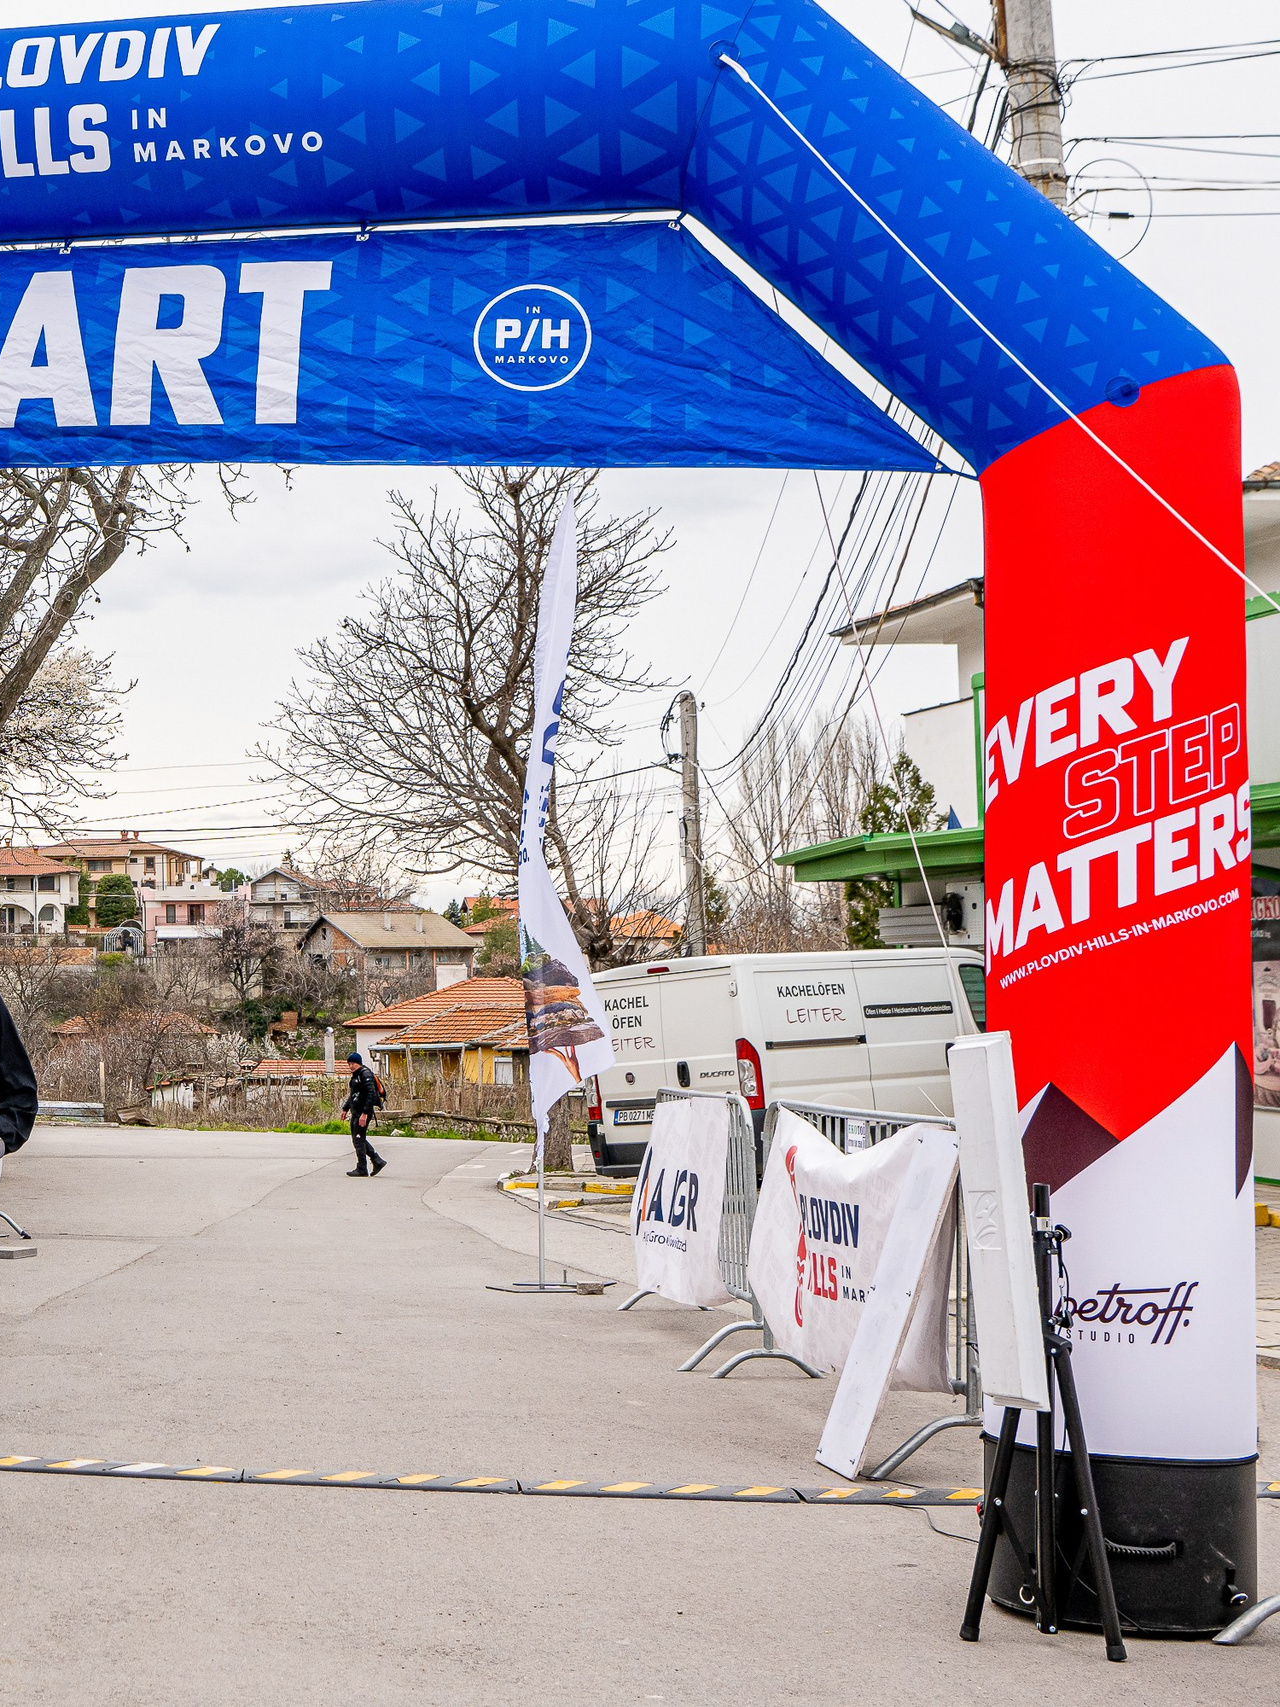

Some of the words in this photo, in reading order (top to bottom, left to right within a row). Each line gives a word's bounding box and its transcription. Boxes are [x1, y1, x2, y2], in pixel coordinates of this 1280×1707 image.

[132, 108, 167, 130] IN
[134, 131, 323, 163] MARKOVO
[526, 306, 540, 314] IN
[495, 318, 570, 352] P/H
[495, 355, 569, 364] MARKOVO
[985, 636, 1190, 813] EVERY
[1063, 702, 1240, 839] STEP
[985, 779, 1252, 976] MATTERS
[1000, 888, 1239, 989] WWW.PLOVDIV-HILLS-IN-MARKOVO.COM
[777, 981, 846, 998] KACHELÖFEN
[604, 995, 649, 1012] KACHEL
[612, 1014, 642, 1030] ÖFEN
[786, 1007, 846, 1023] LEITER
[611, 1036, 656, 1052] EITER
[699, 1070, 735, 1079] DUCATO
[799, 1193, 859, 1248] PLOVDIV
[841, 1265, 852, 1280] IN
[842, 1285, 869, 1303] MAR
[1066, 1329, 1135, 1344] STUDIO
